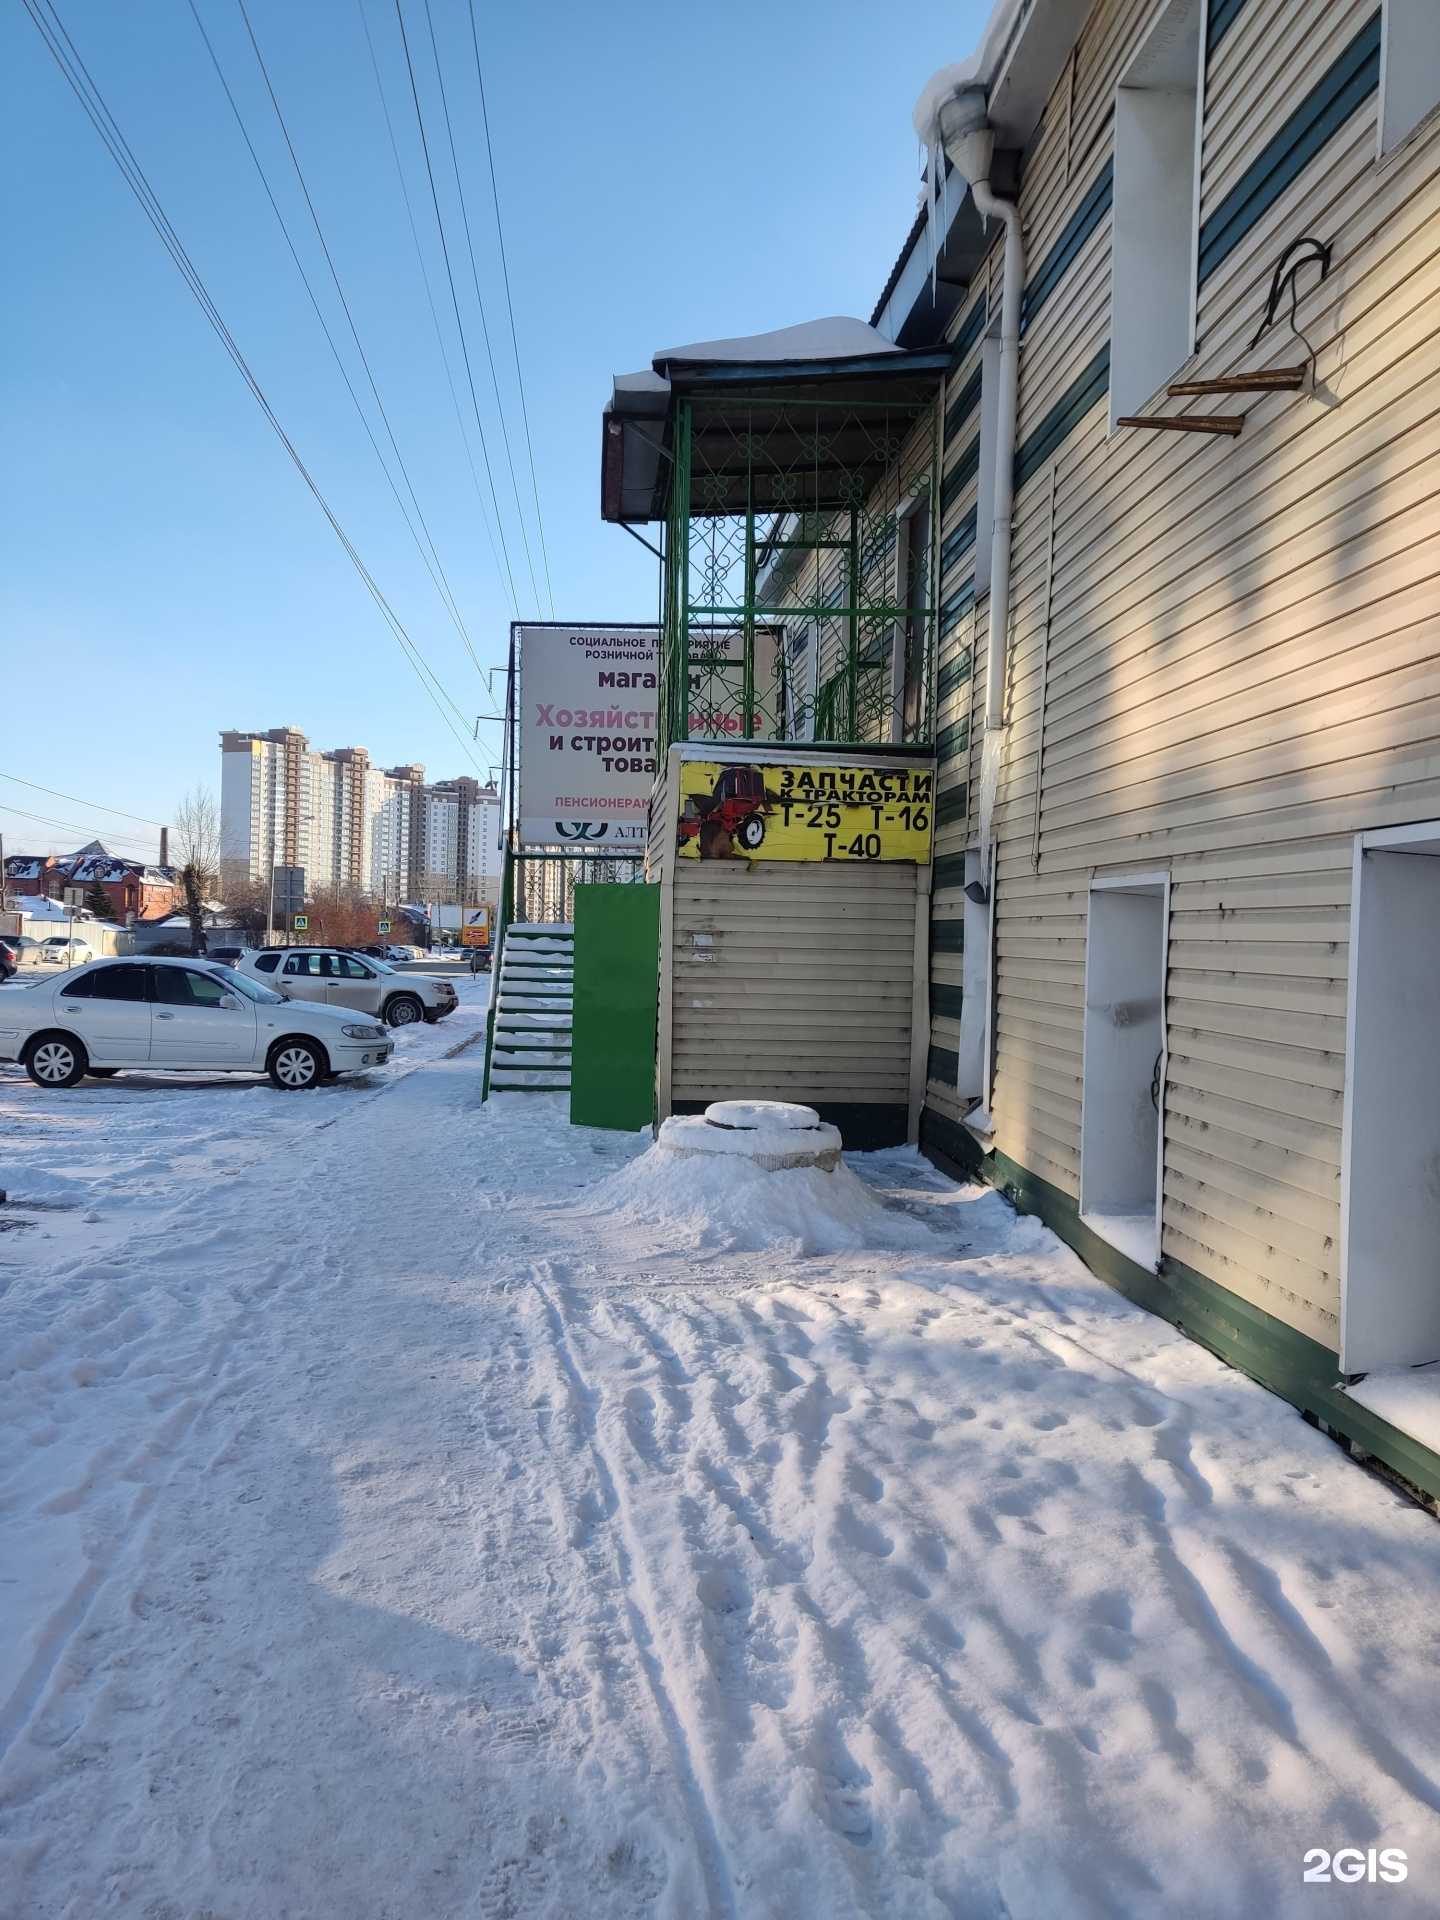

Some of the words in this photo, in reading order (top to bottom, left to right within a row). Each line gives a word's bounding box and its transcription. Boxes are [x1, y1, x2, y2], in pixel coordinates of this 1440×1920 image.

[569, 636, 646, 648] СОЦИАЛЬНОЕ
[651, 639, 731, 650] ПРИЯТИЕ
[585, 649, 653, 661] РОЗНИЧНОЙ
[598, 671, 701, 690] маган
[535, 703, 763, 733] Хозяйстнные
[549, 735, 563, 750] и
[780, 770, 931, 792] ЗАПЧАСТИ
[780, 789, 793, 800] К
[803, 789, 930, 803] ТРАКТОРАМ
[781, 802, 841, 829] Т-25
[871, 805, 929, 832] Т-16
[823, 832, 882, 859] Т-40
